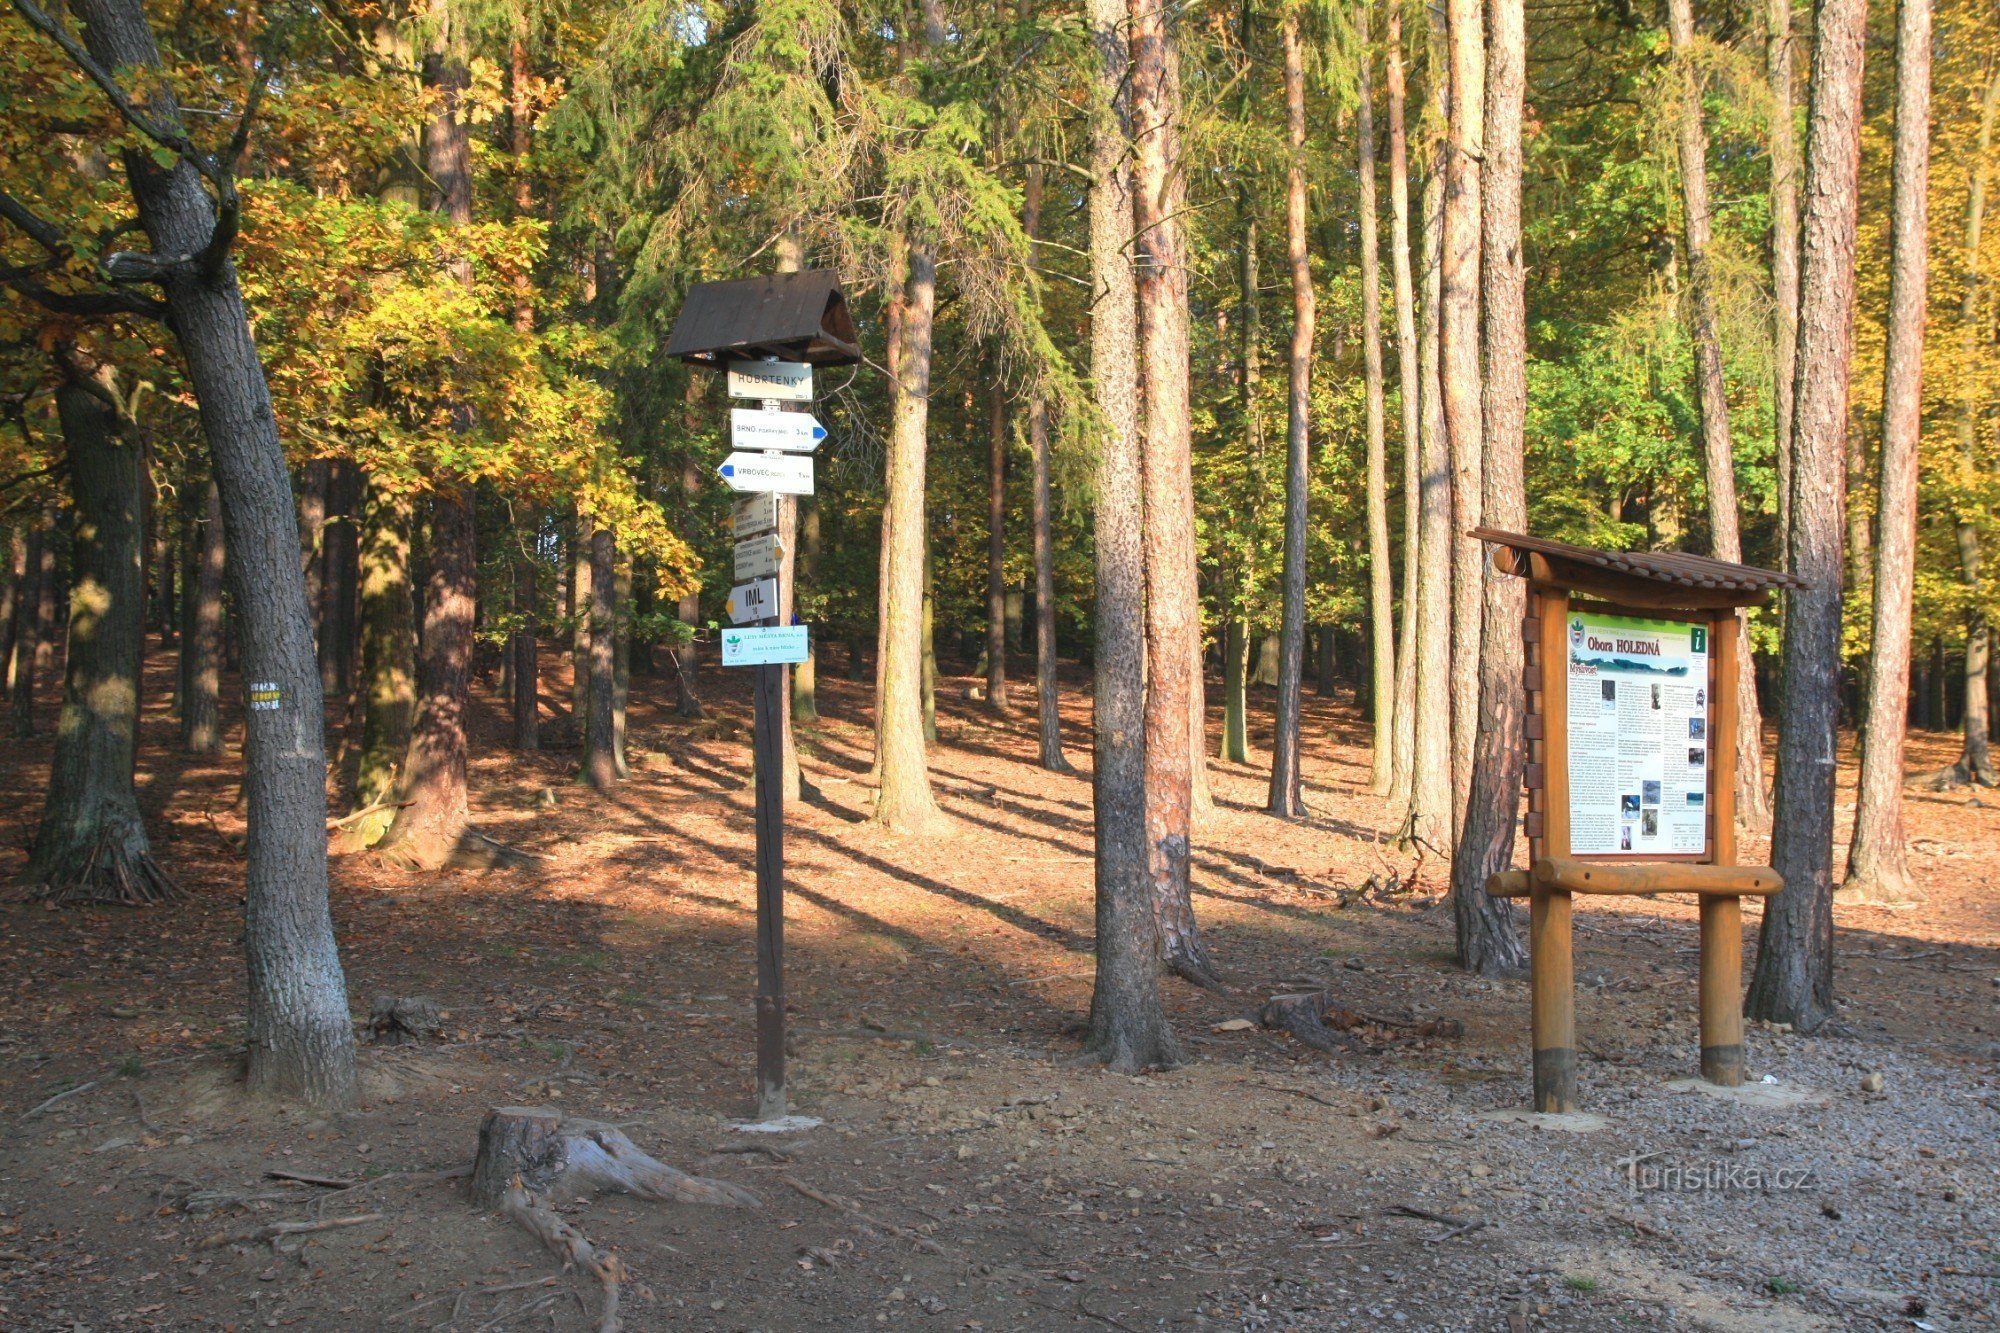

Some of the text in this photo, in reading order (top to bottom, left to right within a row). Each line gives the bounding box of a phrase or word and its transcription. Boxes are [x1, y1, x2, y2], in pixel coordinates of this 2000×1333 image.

[738, 373, 804, 386] HOBRTENKY
[738, 468, 770, 477] VRBOVEC
[745, 588, 764, 607] IML
[1587, 636, 1660, 656] Obora HOLEDNÁ
